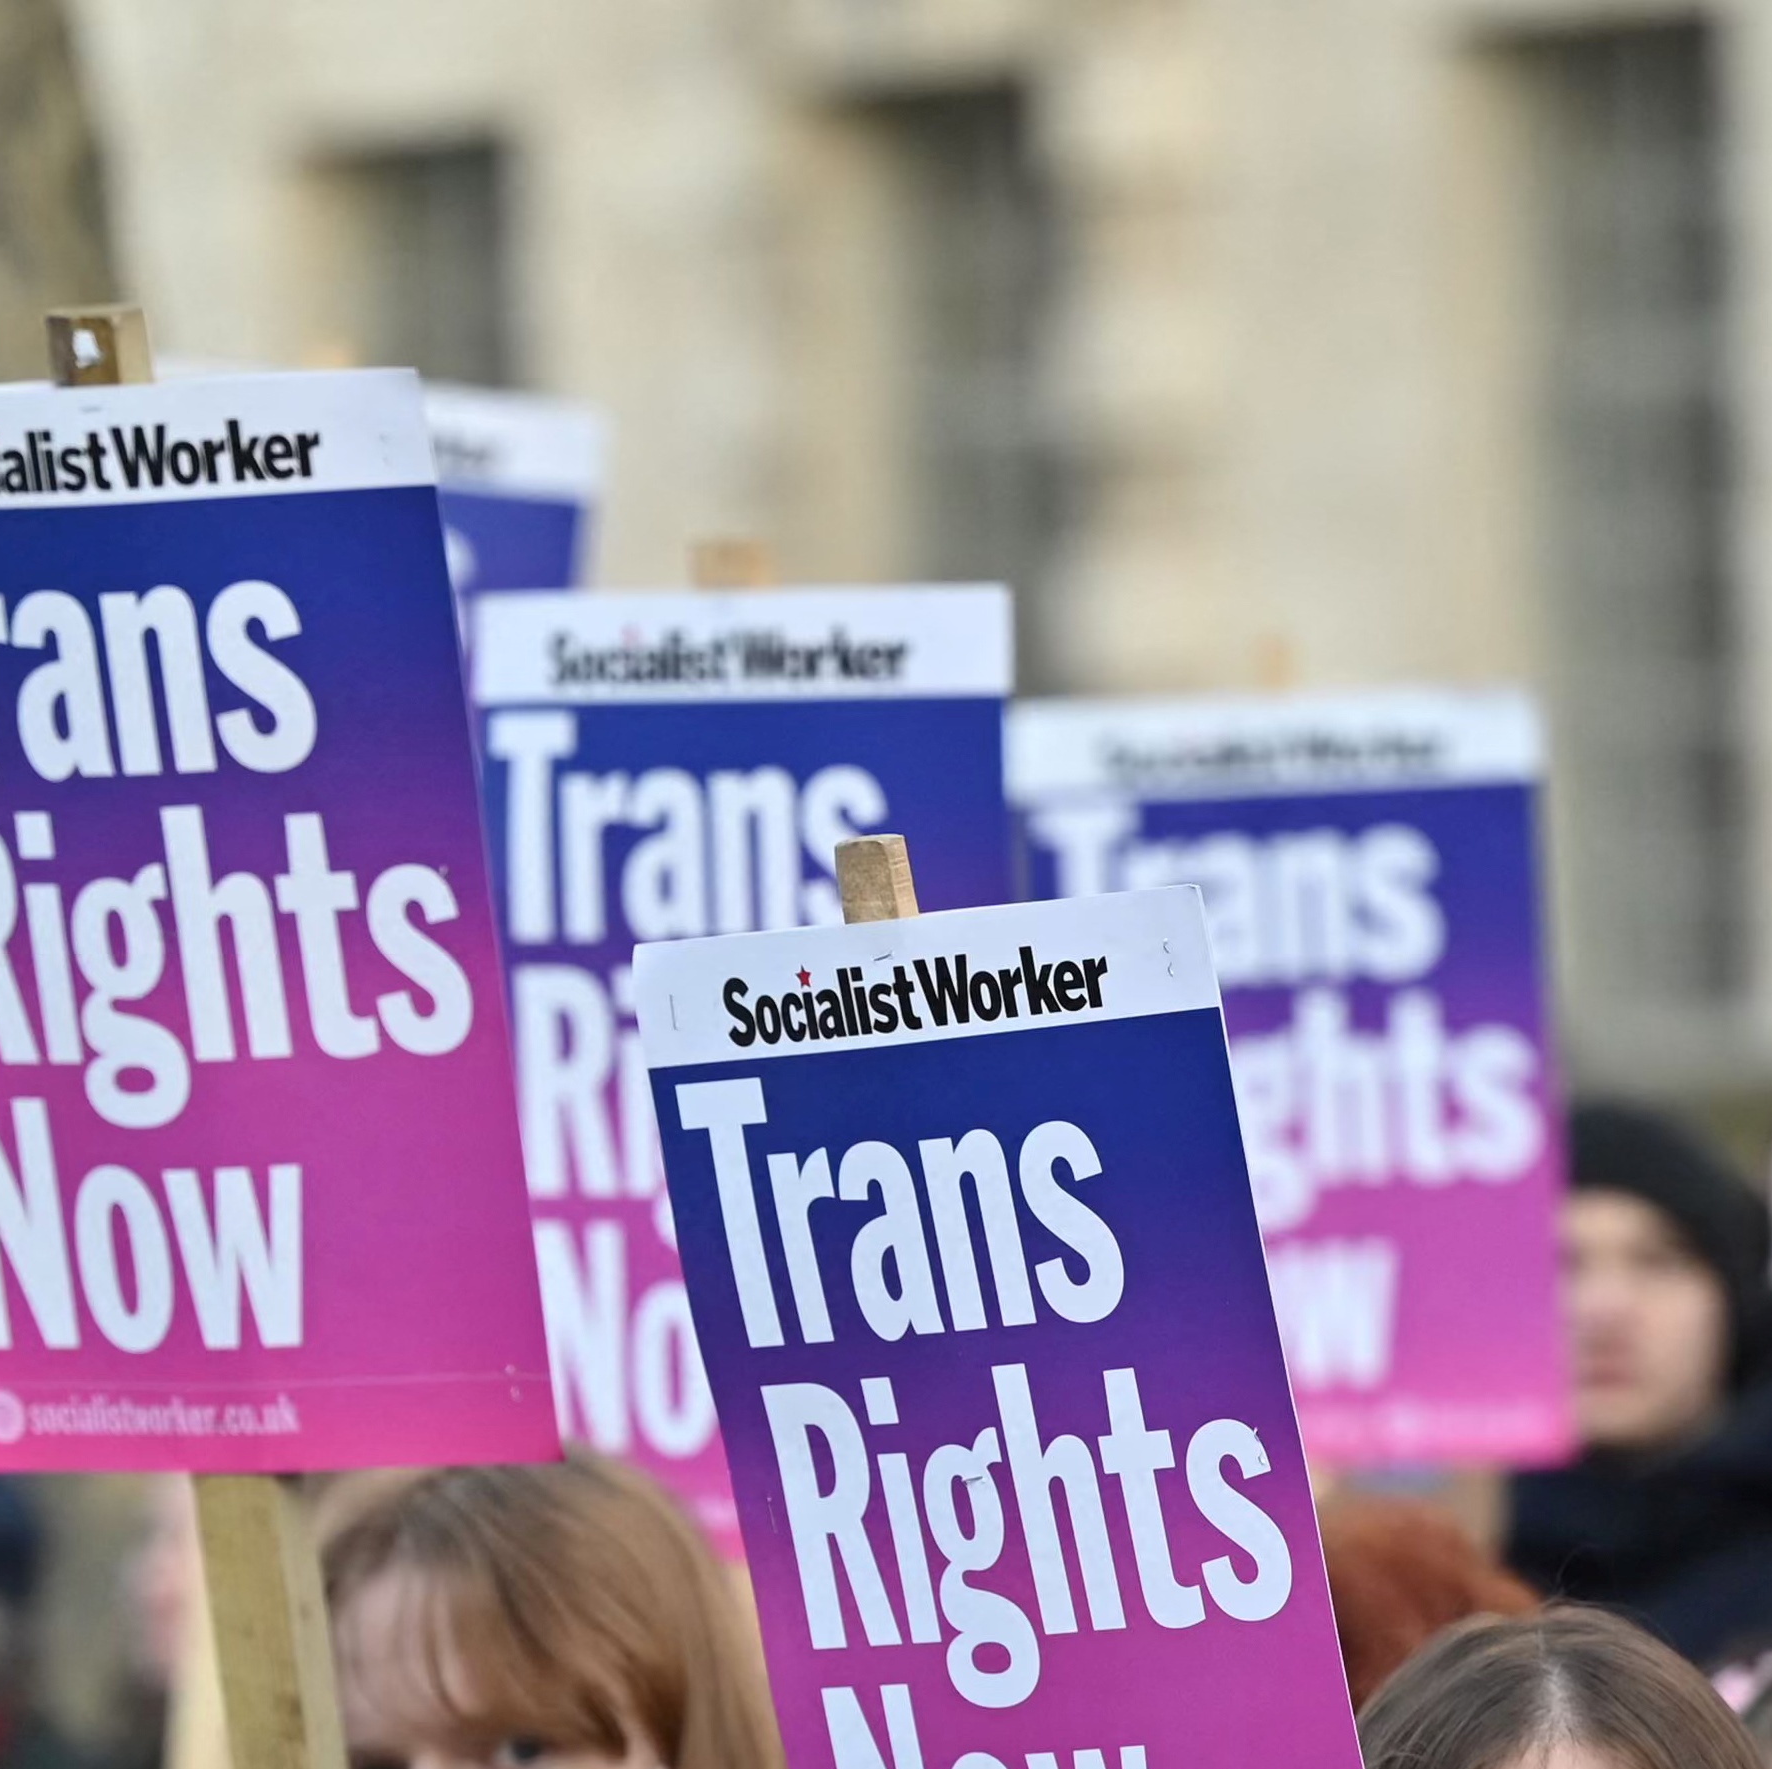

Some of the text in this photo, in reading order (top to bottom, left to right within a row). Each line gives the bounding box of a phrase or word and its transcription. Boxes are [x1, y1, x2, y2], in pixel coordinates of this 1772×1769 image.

[112, 419, 320, 486] Worker
[486, 708, 888, 943] Trans
[722, 946, 1109, 1048] Socialist Worker
[1232, 989, 1545, 1228] ghts
[674, 1076, 1126, 1348] Trans
[28, 1393, 300, 1436] socialistworker.co.uk
[531, 1217, 719, 1459] No
[761, 1362, 1292, 1708] Rights
